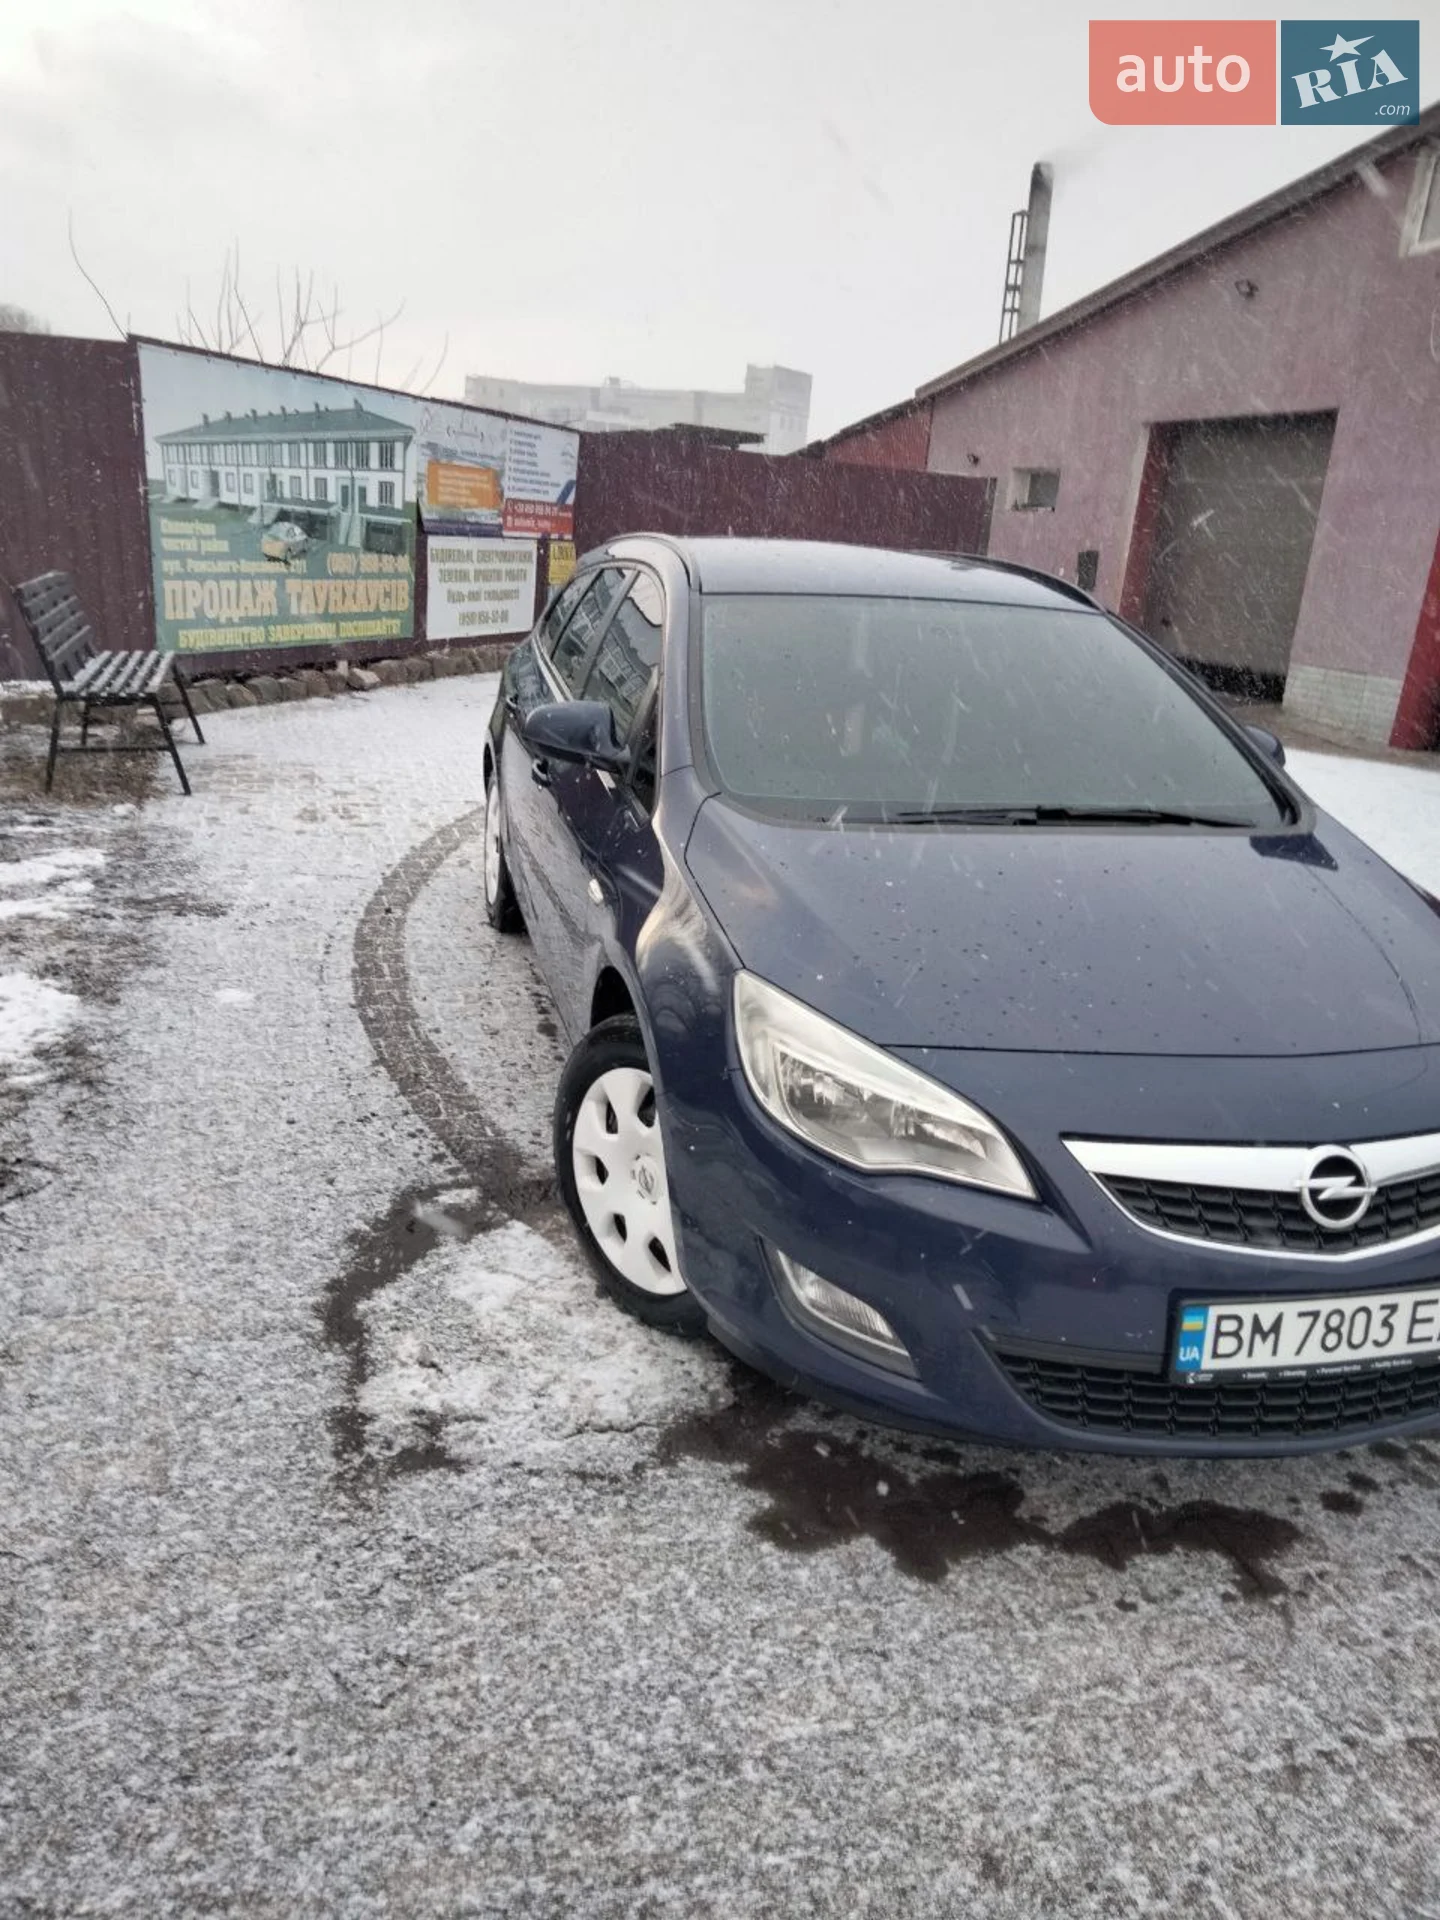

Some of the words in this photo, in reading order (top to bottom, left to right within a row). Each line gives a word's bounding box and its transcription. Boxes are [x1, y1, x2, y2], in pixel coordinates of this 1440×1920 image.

[163, 579, 278, 624] ПРОДАЖ
[285, 578, 409, 616] ТАУНХАУСІВ
[1211, 1311, 1284, 1360] BM
[1294, 1303, 1399, 1356] 7803
[1407, 1298, 1440, 1344] E
[1178, 1345, 1200, 1362] UA
